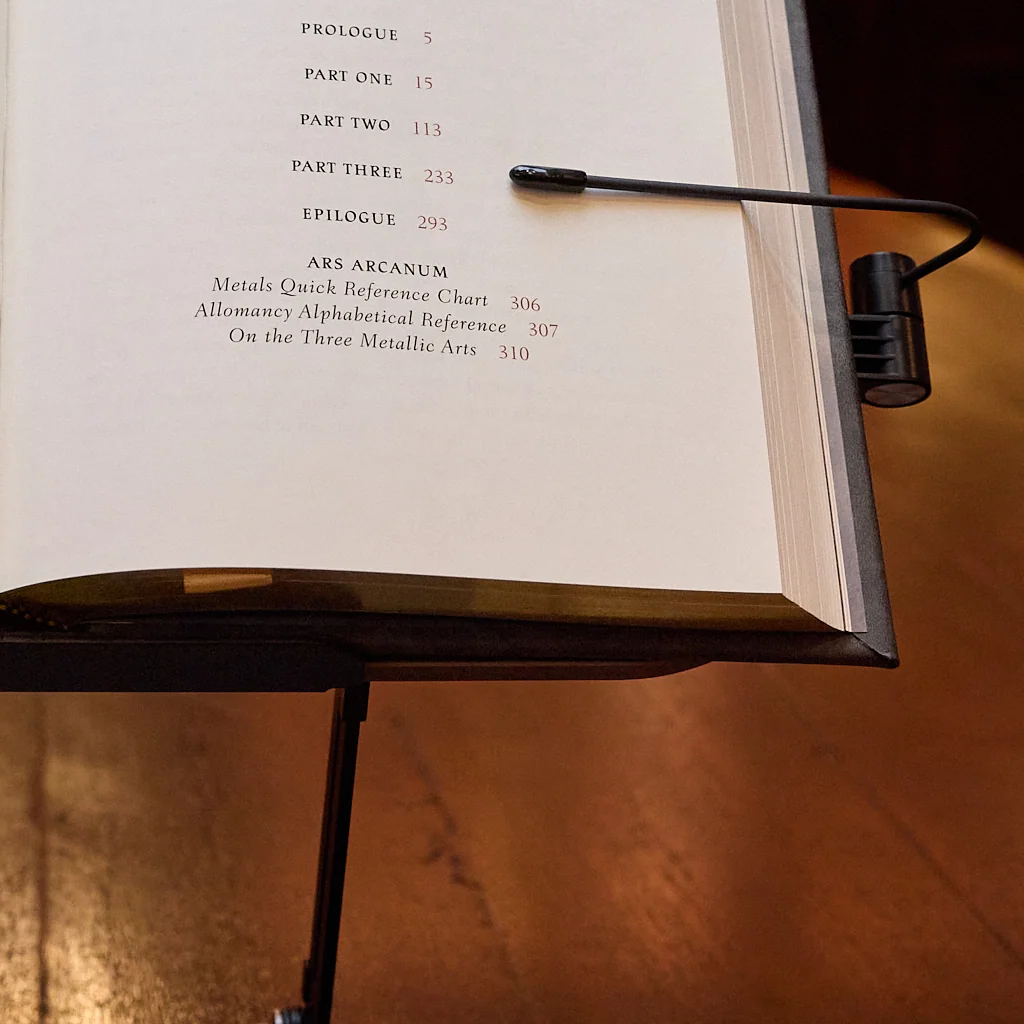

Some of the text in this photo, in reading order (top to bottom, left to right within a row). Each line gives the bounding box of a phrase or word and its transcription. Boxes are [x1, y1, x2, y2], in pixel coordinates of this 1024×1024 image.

[300, 22, 432, 45] PROLOGUE 5
[304, 67, 433, 90] PART ONE 15
[299, 113, 442, 137] PART TWO 113
[291, 159, 454, 185] PART THREE 233
[302, 207, 448, 232] EPILOGUE 293
[306, 256, 449, 279] ARS ARCANUM
[211, 276, 541, 312] Metals Quick Reference Chart 306
[193, 301, 559, 338] Allomancy Alphabetical Reference 307
[229, 327, 530, 361] On the Three Metallic Arts 310
